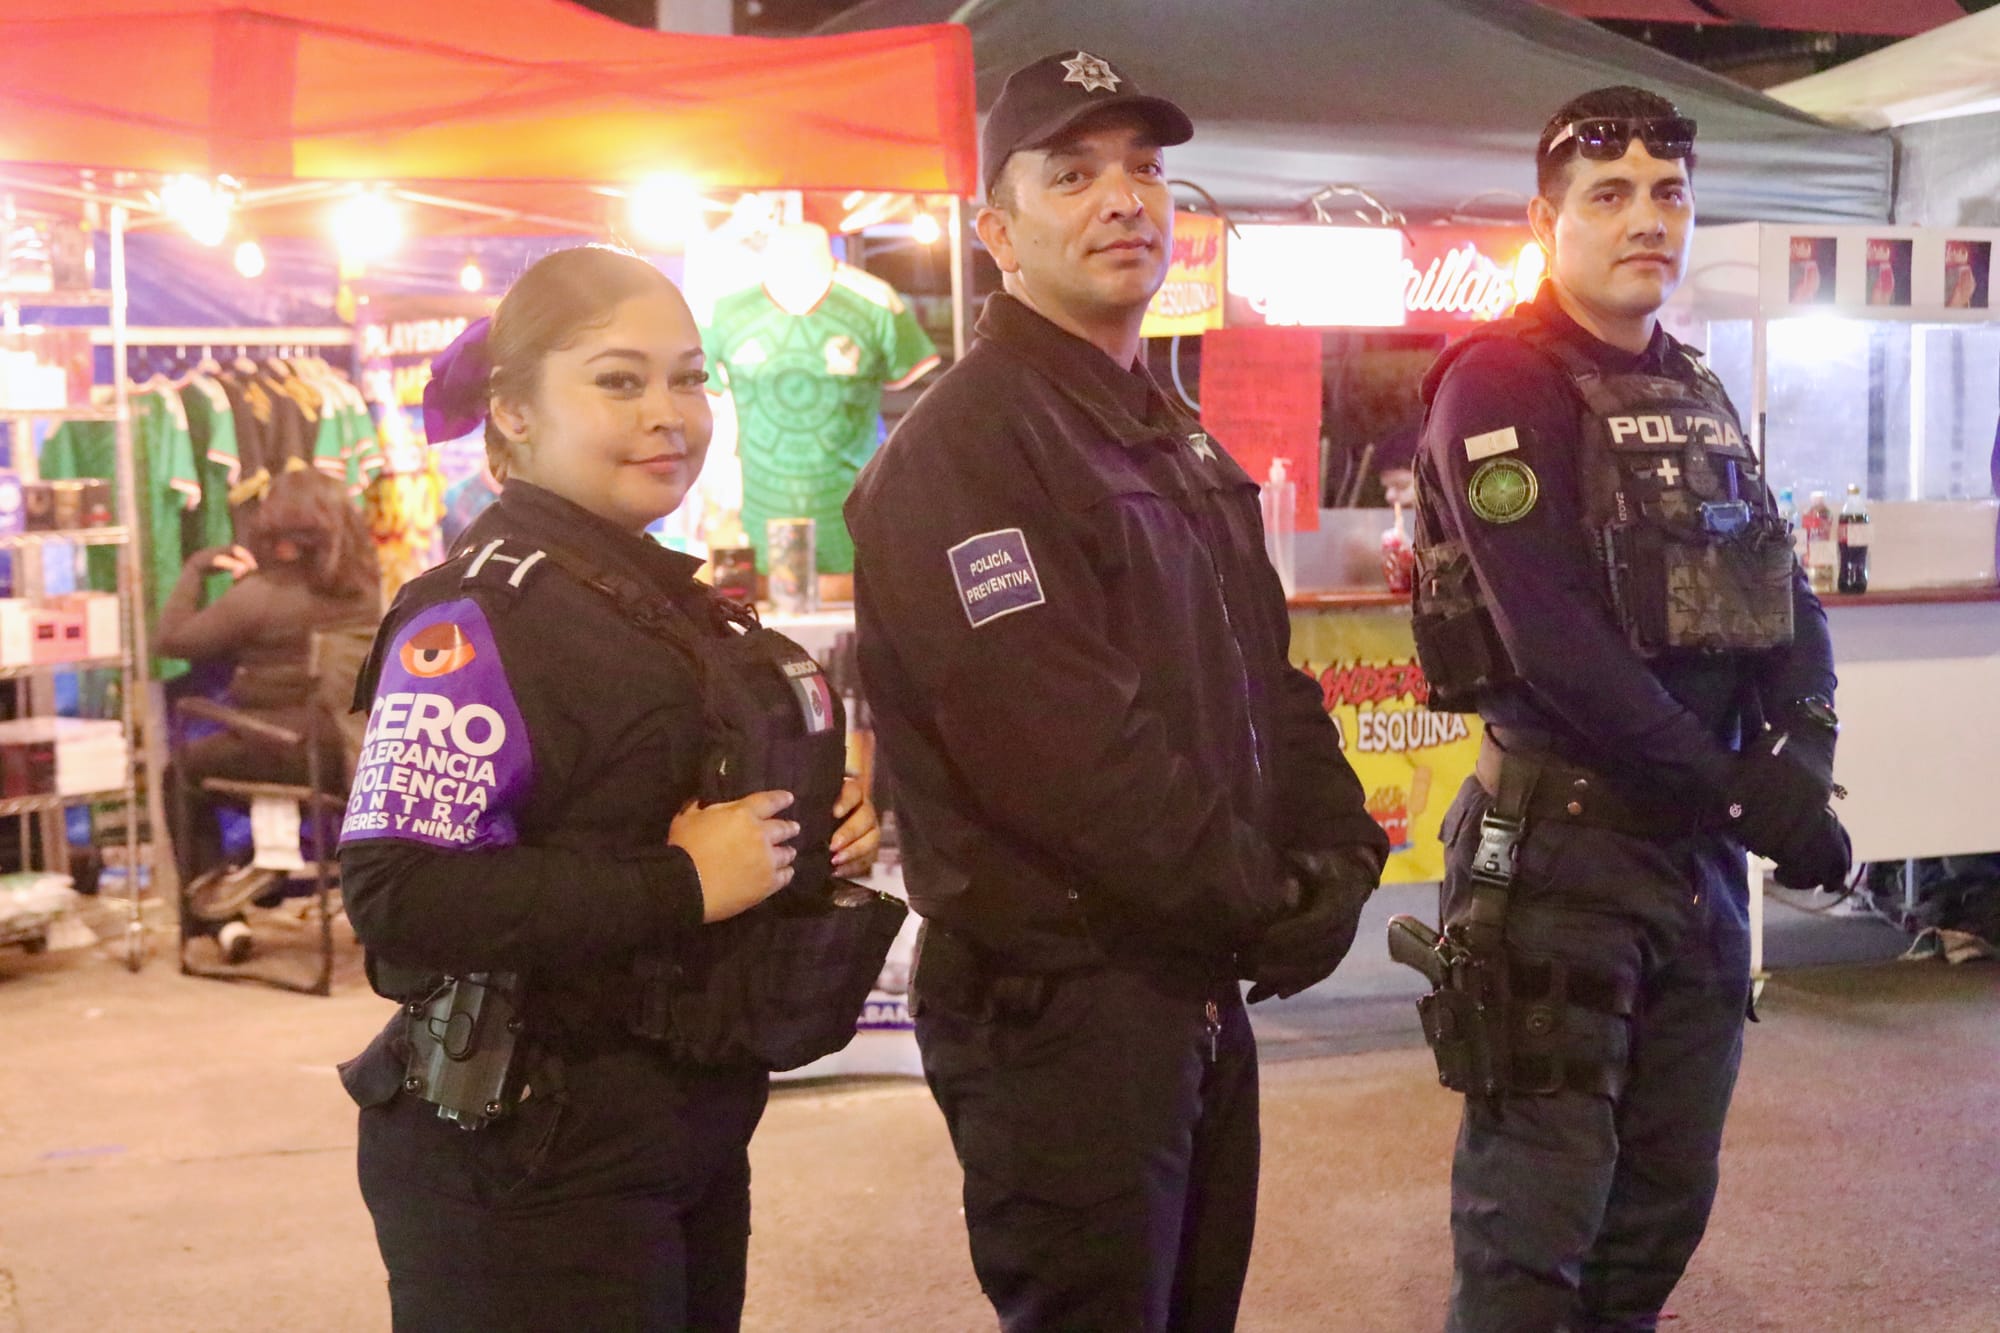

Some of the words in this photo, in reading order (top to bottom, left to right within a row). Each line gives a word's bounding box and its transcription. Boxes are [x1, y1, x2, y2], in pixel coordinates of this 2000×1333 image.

[969, 549, 1012, 576] POLICÍA
[966, 569, 1032, 604] PREVENTIVA
[364, 692, 506, 756] CERO
[1358, 711, 1468, 751] ESQUINA
[360, 741, 496, 787] OLERANCIA
[351, 790, 480, 829] ONTRA
[395, 814, 410, 830] Y
